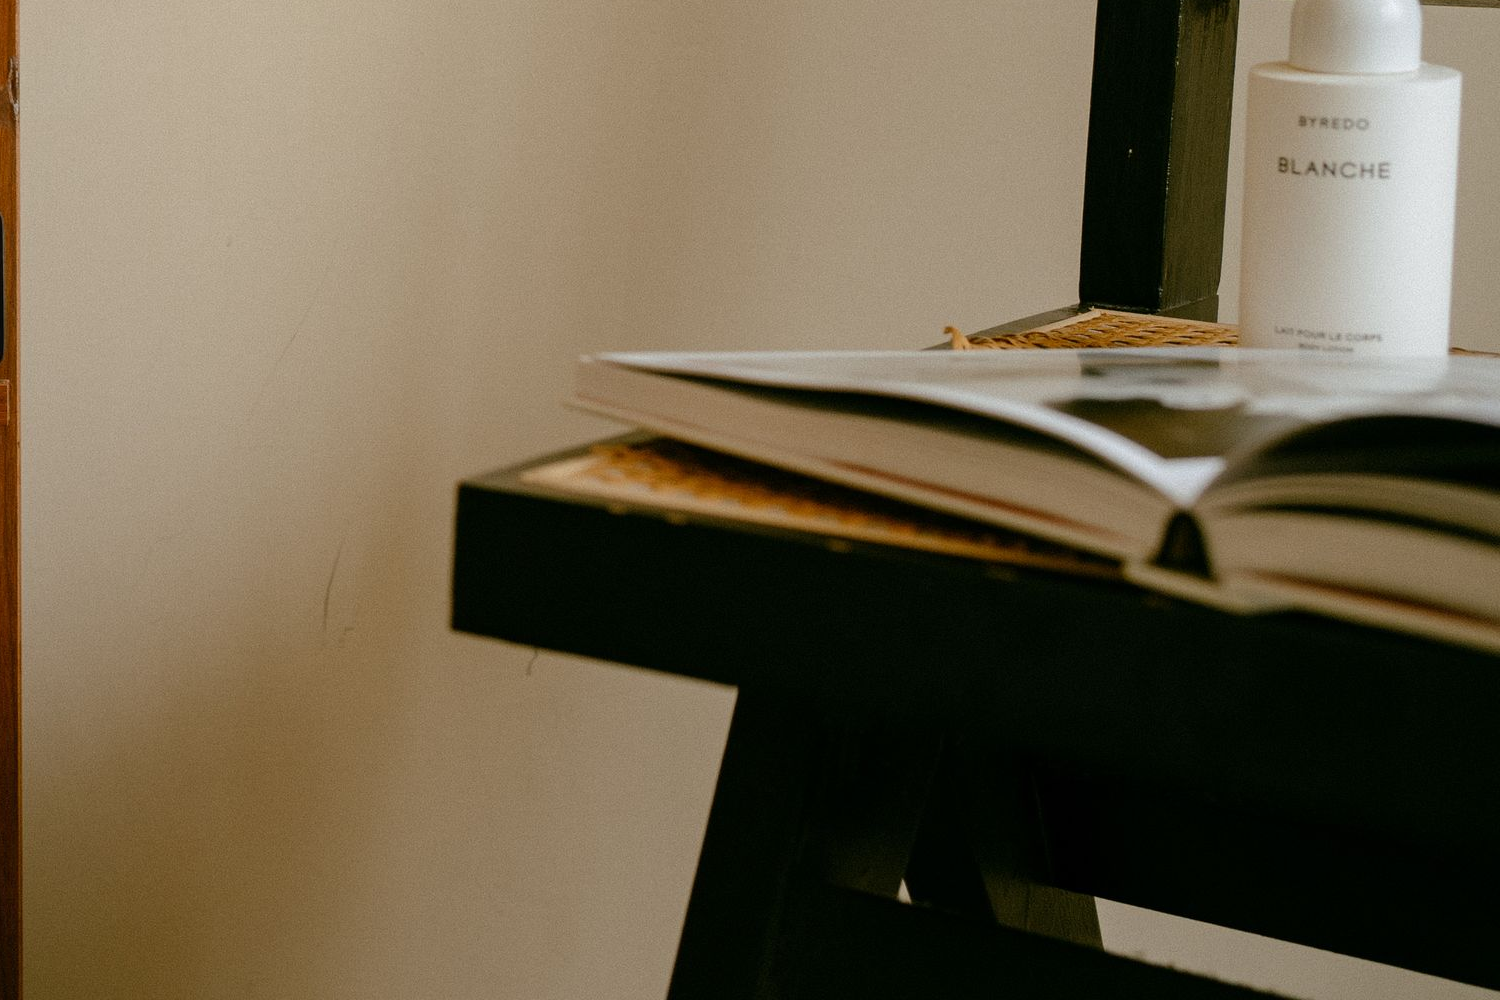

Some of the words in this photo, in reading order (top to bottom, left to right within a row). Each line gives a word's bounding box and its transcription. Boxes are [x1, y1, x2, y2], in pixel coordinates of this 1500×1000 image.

[1298, 115, 1370, 131] BYREDO
[1278, 156, 1391, 179] BLANCHE
[1296, 328, 1325, 339] POUR
[1329, 333, 1341, 342] LE
[1345, 333, 1382, 342] CORPS
